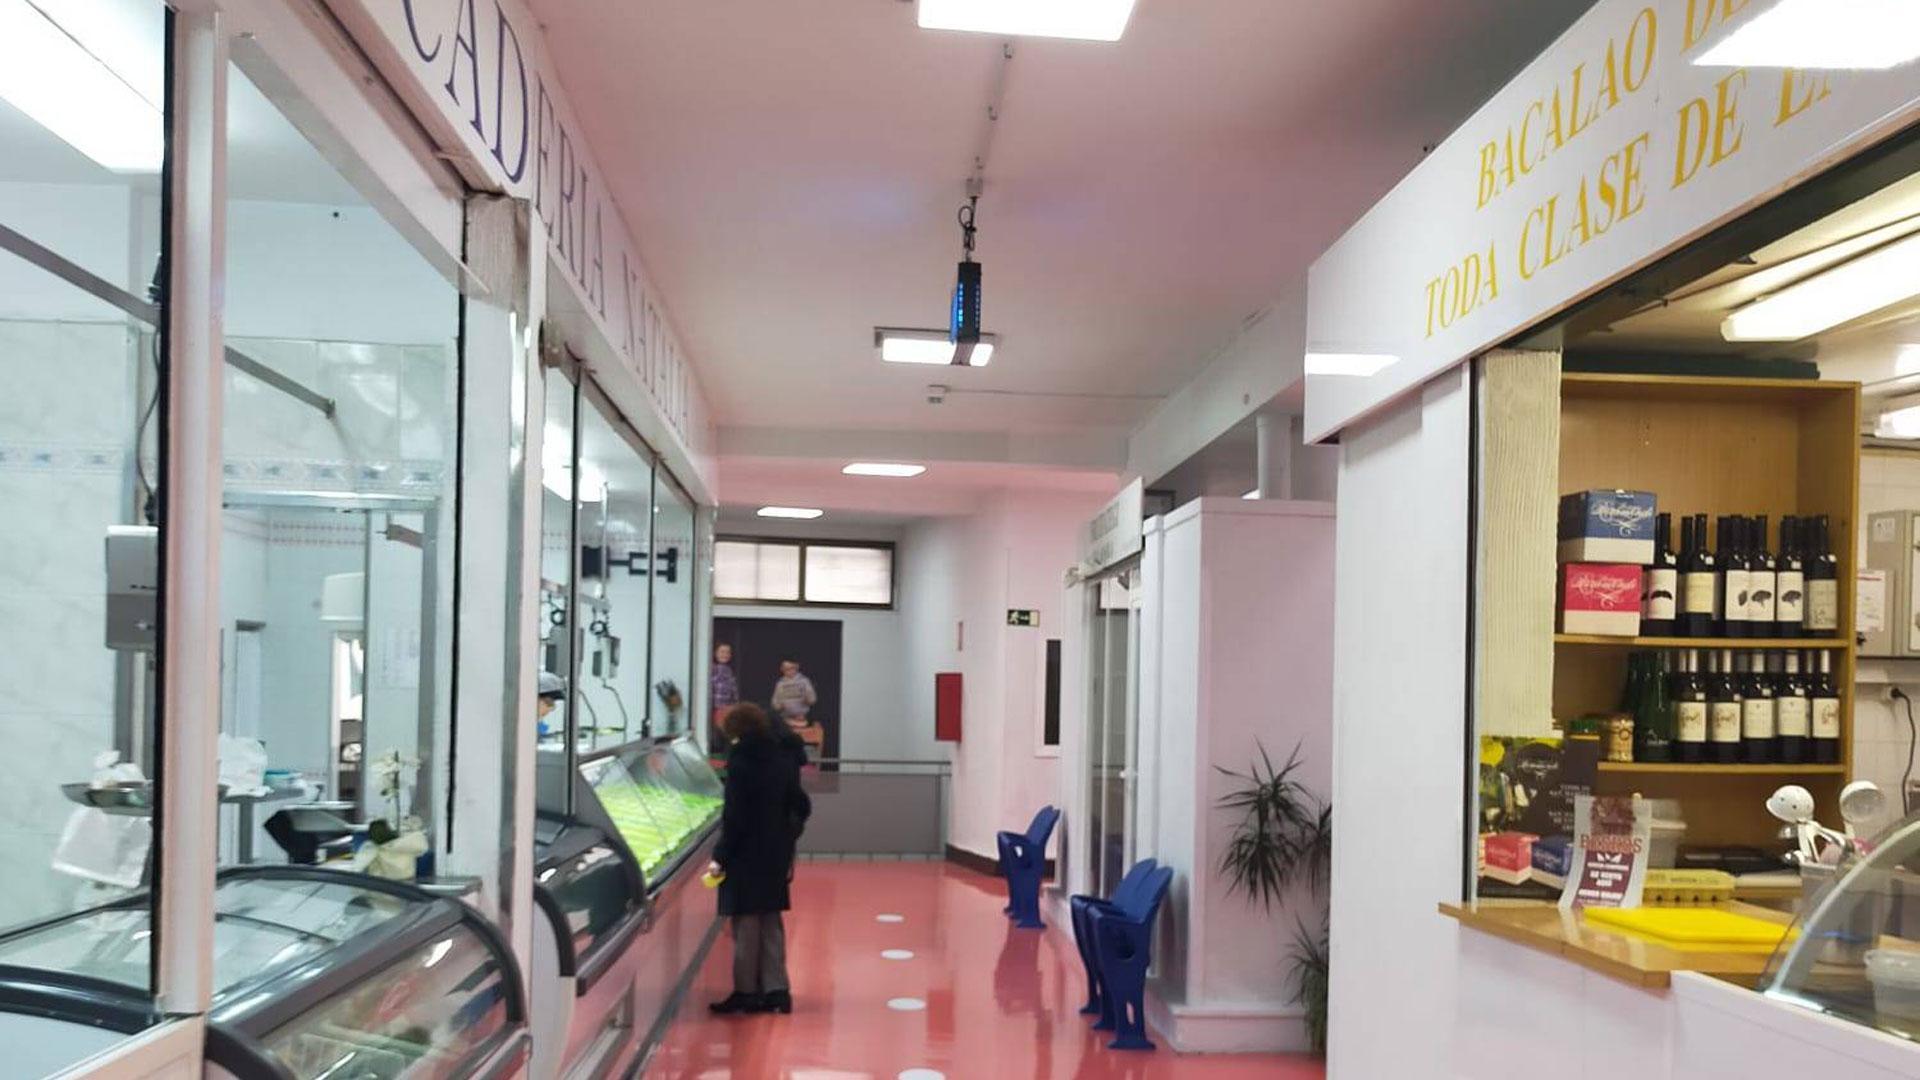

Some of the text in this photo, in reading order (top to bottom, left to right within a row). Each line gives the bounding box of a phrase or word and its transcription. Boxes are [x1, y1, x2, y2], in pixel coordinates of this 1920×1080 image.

[1424, 240, 1499, 338] TODA
[1518, 131, 1648, 281] CLASE
[1671, 67, 1748, 190] DE
[1476, 6, 1657, 212] BACALAO
[1680, 0, 1752, 57] D
